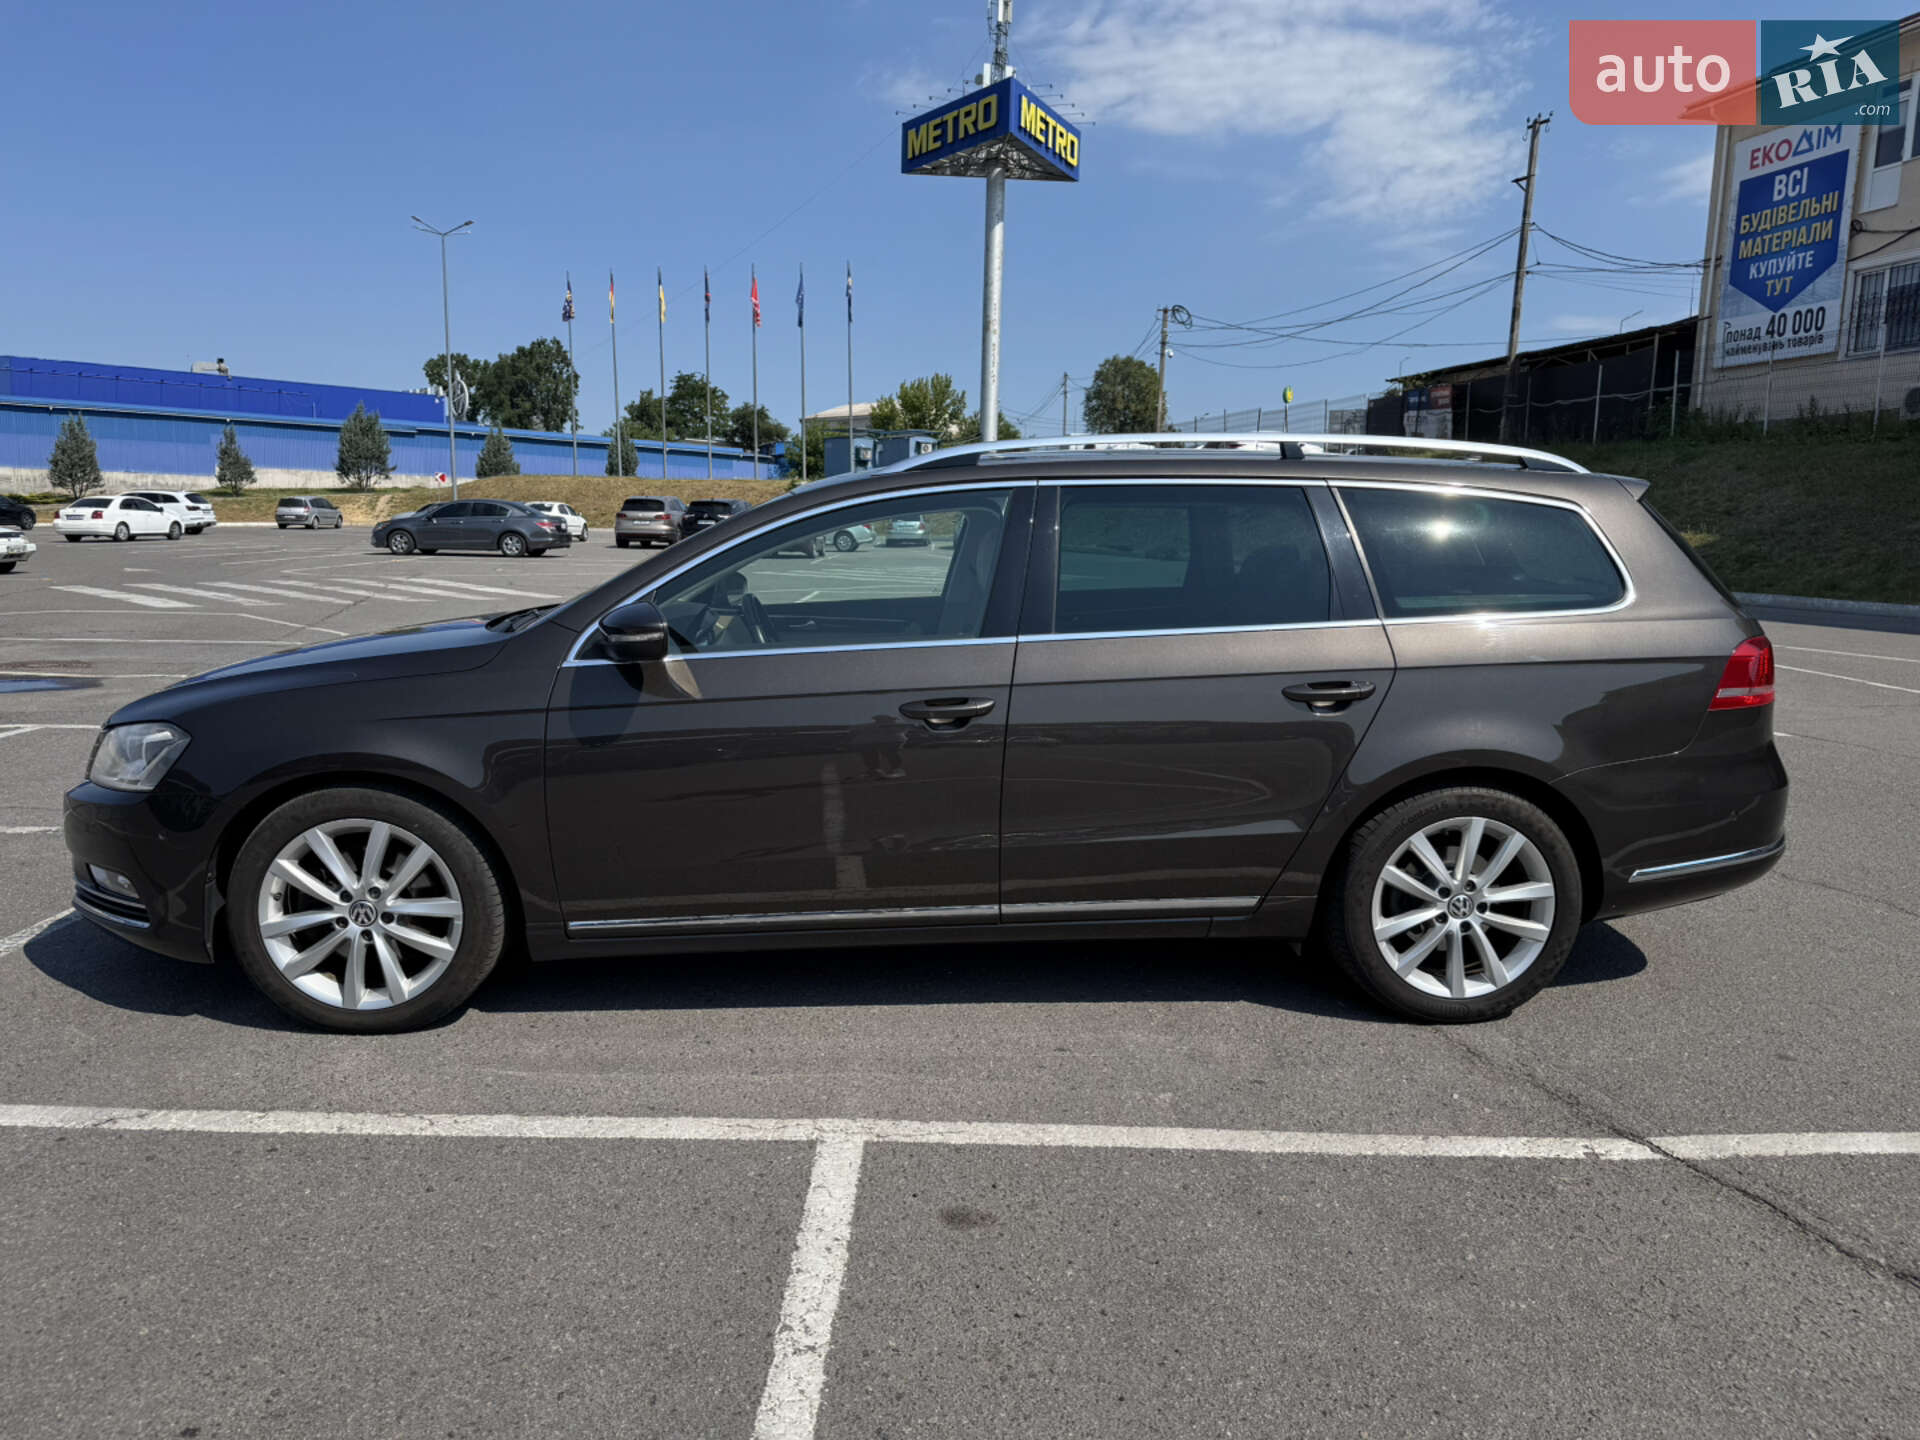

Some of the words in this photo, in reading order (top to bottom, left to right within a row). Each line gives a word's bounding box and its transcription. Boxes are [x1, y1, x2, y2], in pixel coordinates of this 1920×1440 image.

[907, 93, 998, 160] METRO
[1020, 94, 1079, 168] METRO
[1749, 124, 1842, 170] ЕКОДІМ
[1772, 166, 1809, 202] ВСІ
[1739, 190, 1839, 235] БУДІВЕЛЬНІ
[1738, 218, 1833, 260] МАТЕРІАЛИ
[1749, 250, 1814, 280] КУПУЙТЕ
[1765, 276, 1793, 297] ТУТ
[1726, 326, 1761, 343] понад
[1765, 313, 1788, 338] 40
[1791, 306, 1826, 335] 000
